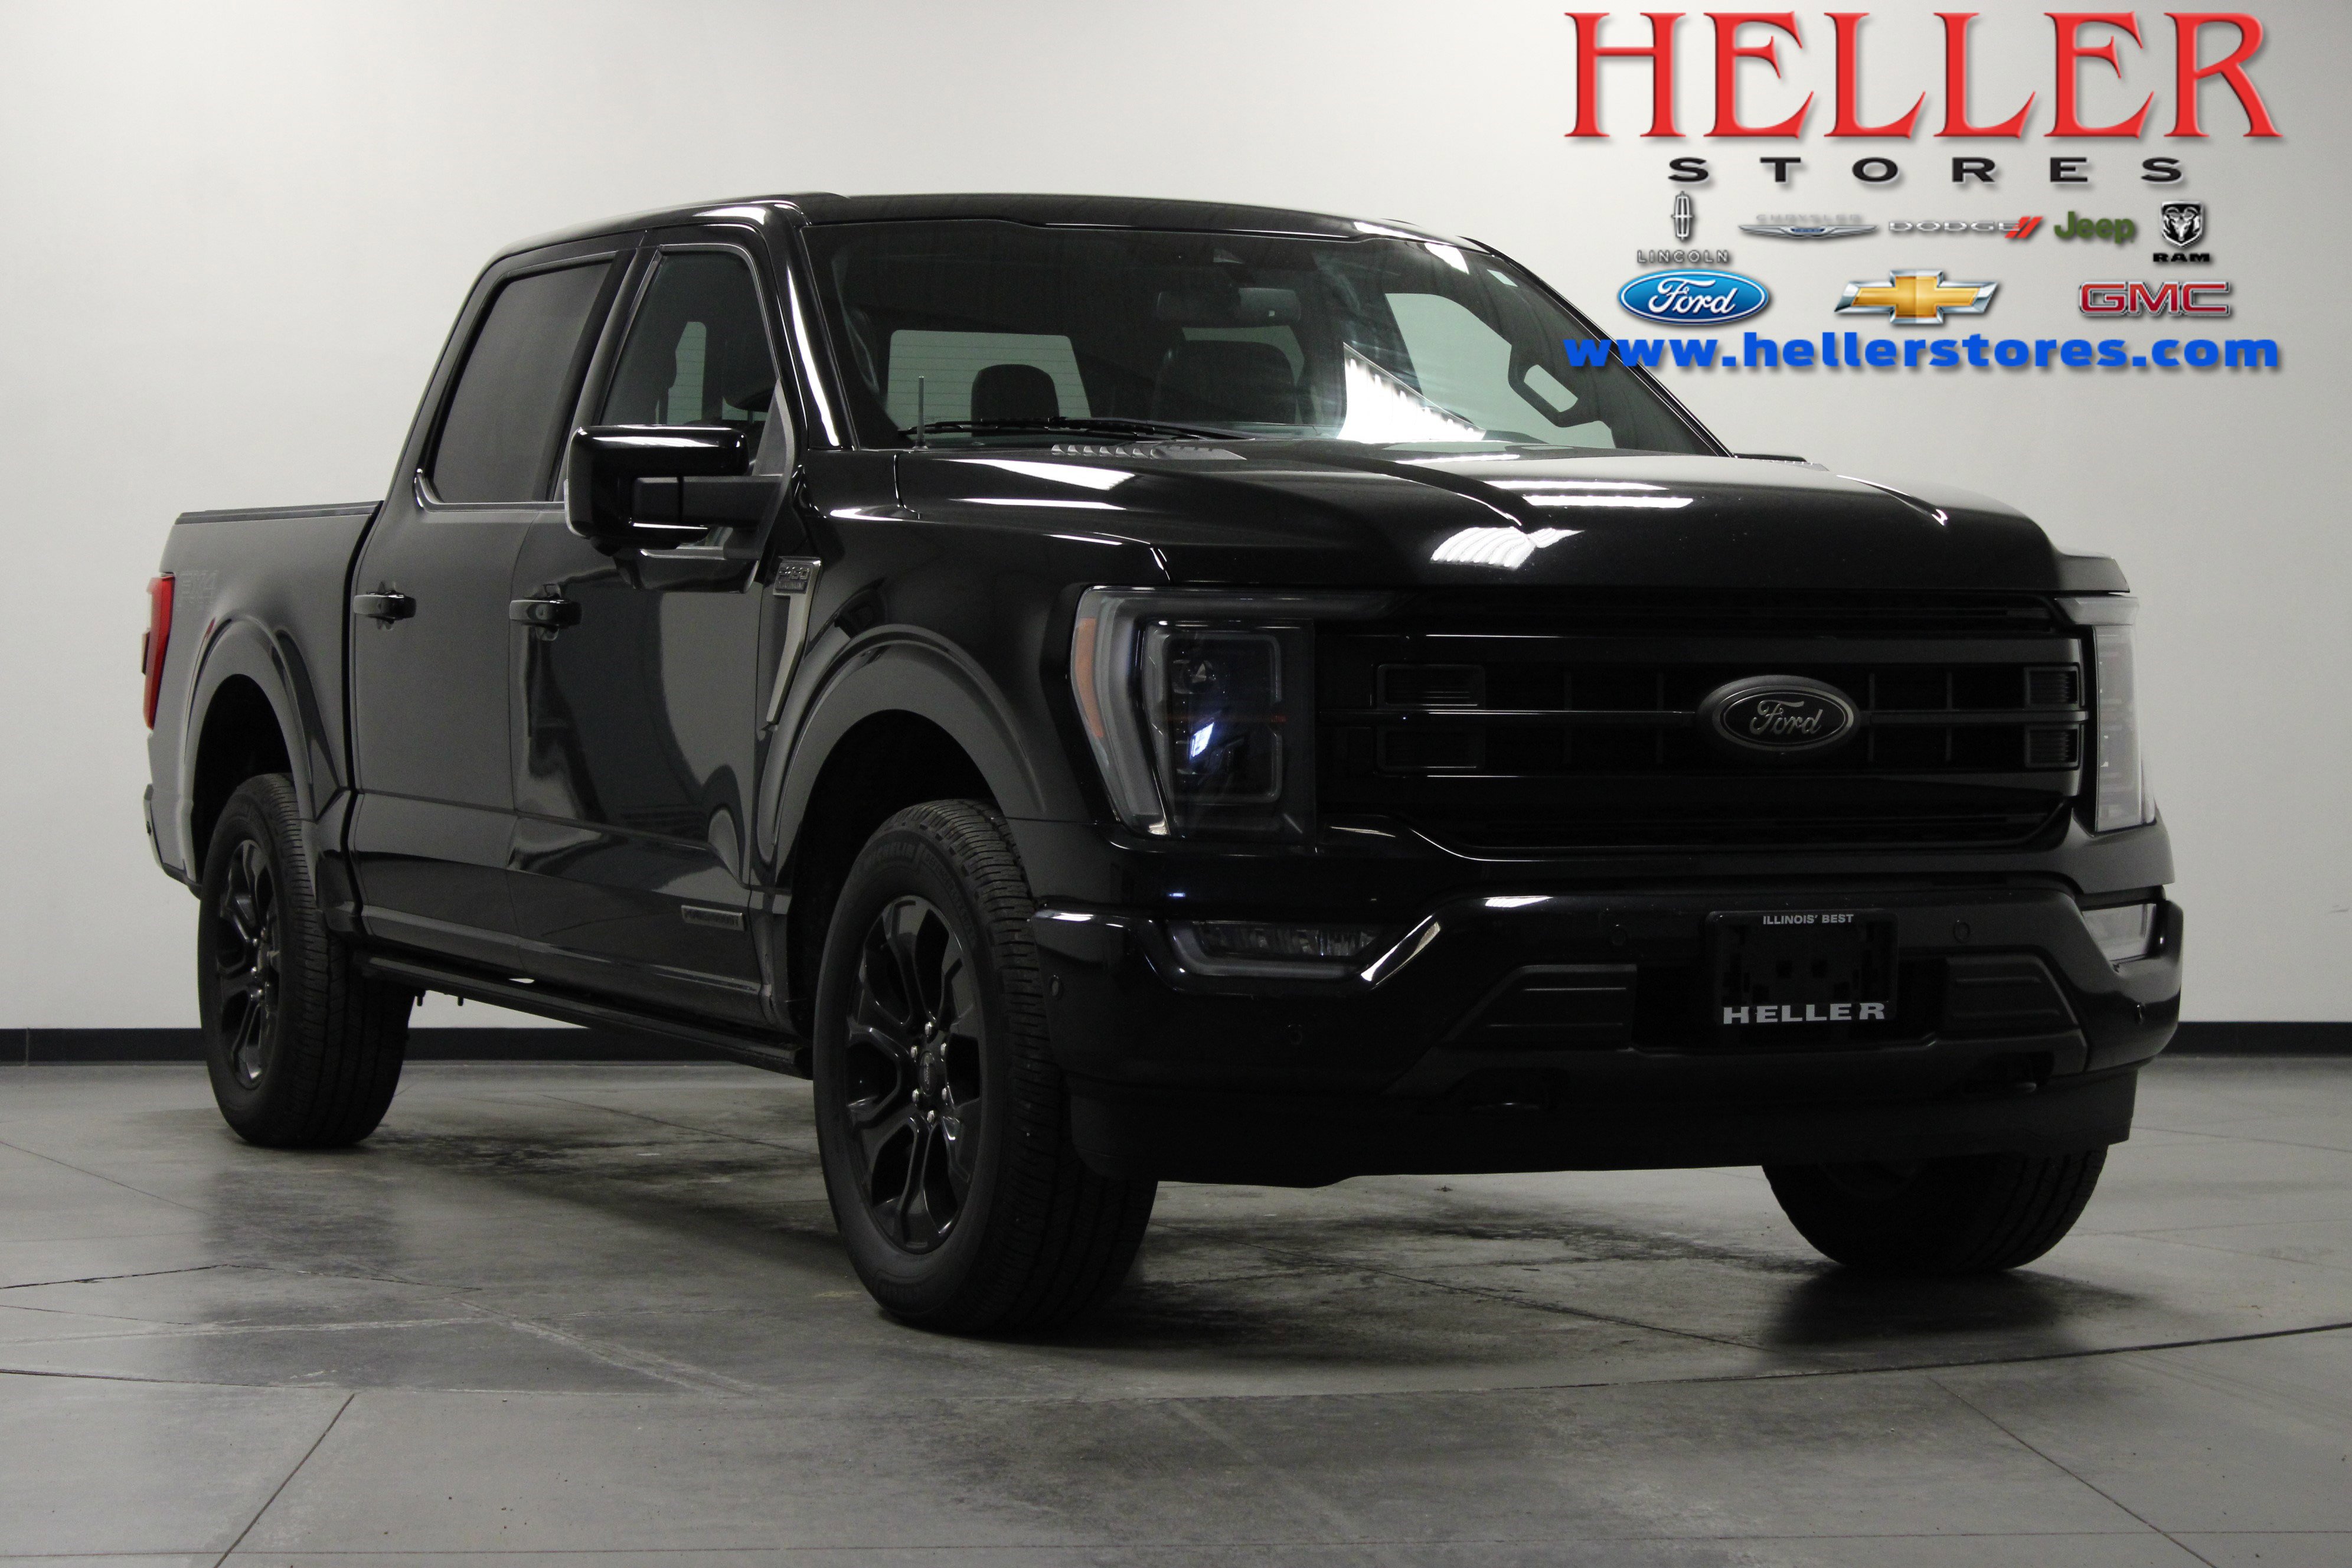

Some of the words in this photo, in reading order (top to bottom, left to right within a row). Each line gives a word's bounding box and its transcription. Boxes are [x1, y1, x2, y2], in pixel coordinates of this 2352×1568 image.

[1749, 699, 1823, 735] Ford
[1822, 914, 1854, 923] BEST
[1723, 1003, 1885, 1024] HELLER
